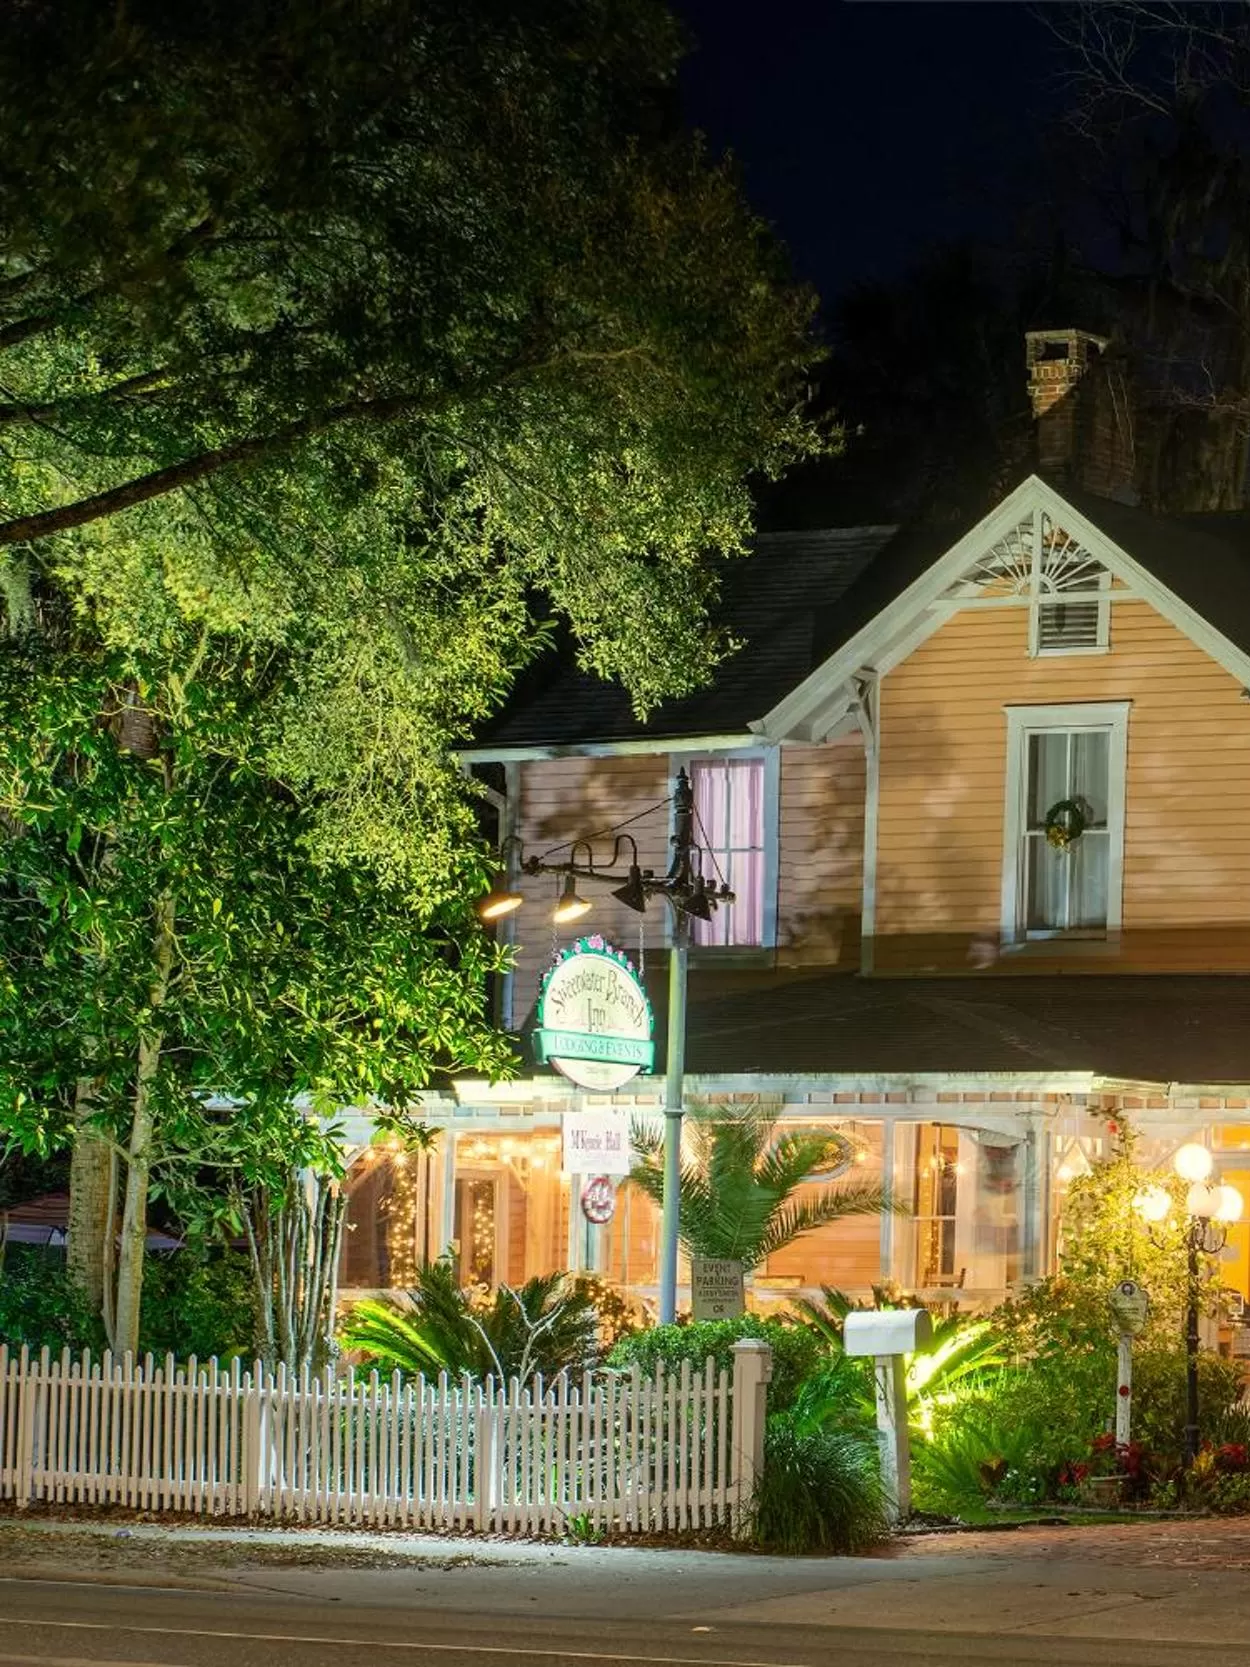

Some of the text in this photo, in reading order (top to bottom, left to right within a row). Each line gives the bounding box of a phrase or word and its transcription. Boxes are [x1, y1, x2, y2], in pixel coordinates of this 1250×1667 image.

[587, 998, 606, 1032] Inn
[703, 1263, 731, 1273] EVENT
[696, 1276, 739, 1286] PARKING
